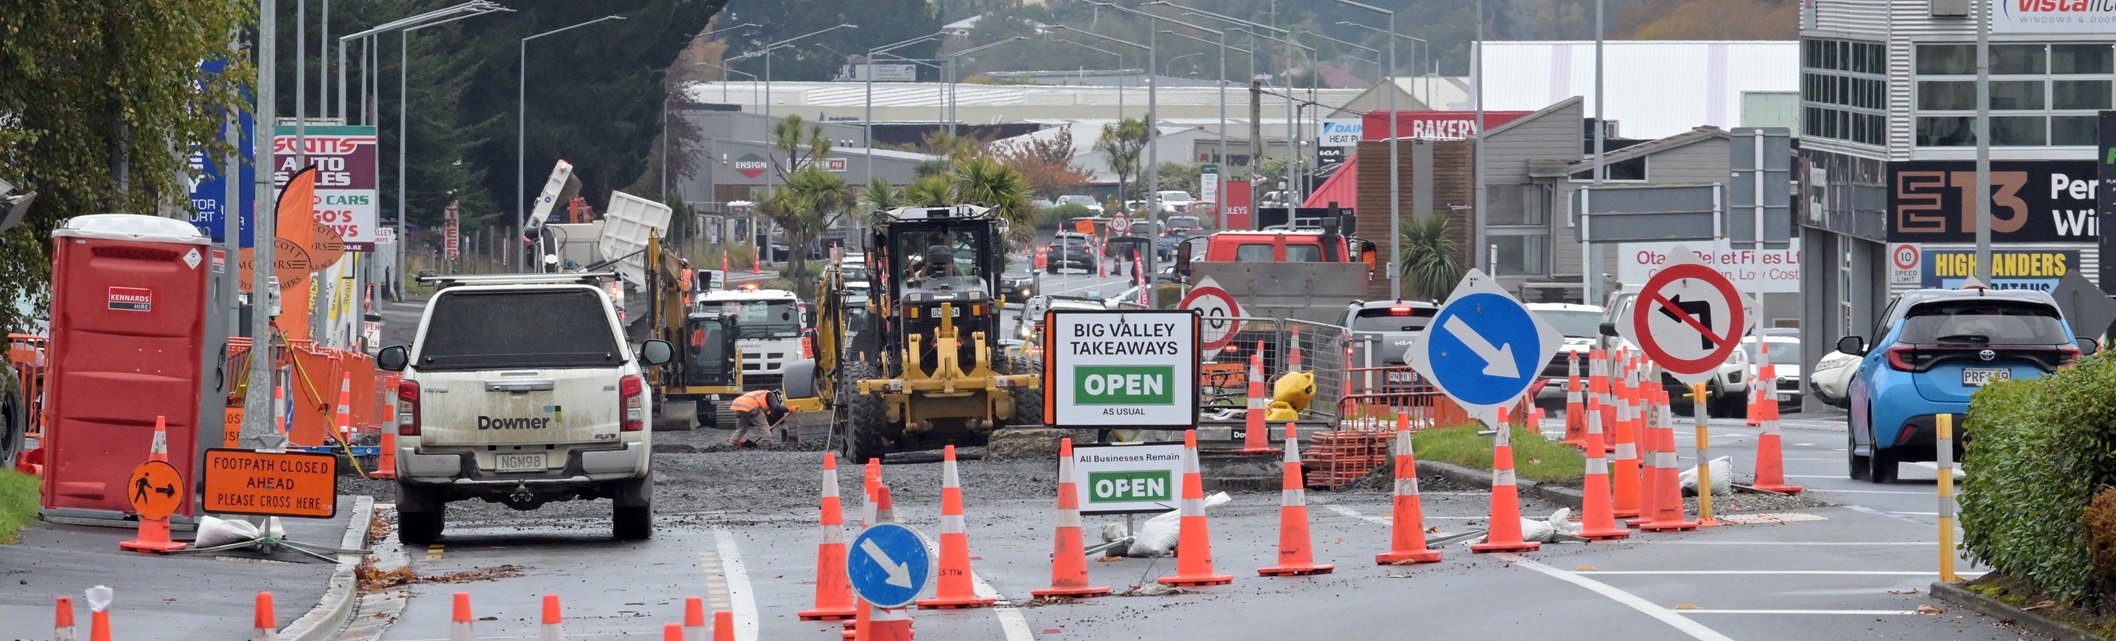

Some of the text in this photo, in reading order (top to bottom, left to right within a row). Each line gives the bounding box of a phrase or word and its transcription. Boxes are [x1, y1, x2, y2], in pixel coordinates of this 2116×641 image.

[1413, 119, 1477, 141] BAKERY
[1329, 135, 1349, 143] HEAT
[281, 157, 345, 171] ATO
[735, 161, 767, 169] ENSIGN
[275, 172, 351, 186] SES
[326, 196, 369, 205] CARS
[2052, 208, 2099, 236] Wi
[1742, 251, 1781, 264] Fies
[1900, 252, 1911, 261] 10
[1935, 253, 2066, 276] HIGHANDERS
[110, 294, 149, 303] KENNARDS
[134, 303, 149, 311] HIRE
[366, 331, 373, 339] 7
[1074, 323, 1175, 337] BIG VALLEY
[1070, 341, 1178, 355] TAKEAWAYS
[1084, 373, 1163, 396] OPEN
[1102, 408, 1146, 416] AS USUAL
[477, 415, 550, 431] Downer
[501, 456, 541, 468] NGM98
[1079, 453, 1180, 463] All Businesses Remain
[214, 457, 329, 474] FOOTPATH CLOSED
[246, 476, 295, 490] AHEAD
[1095, 477, 1165, 499] OPEN
[217, 493, 321, 510] PLEASE CROSS HERE
